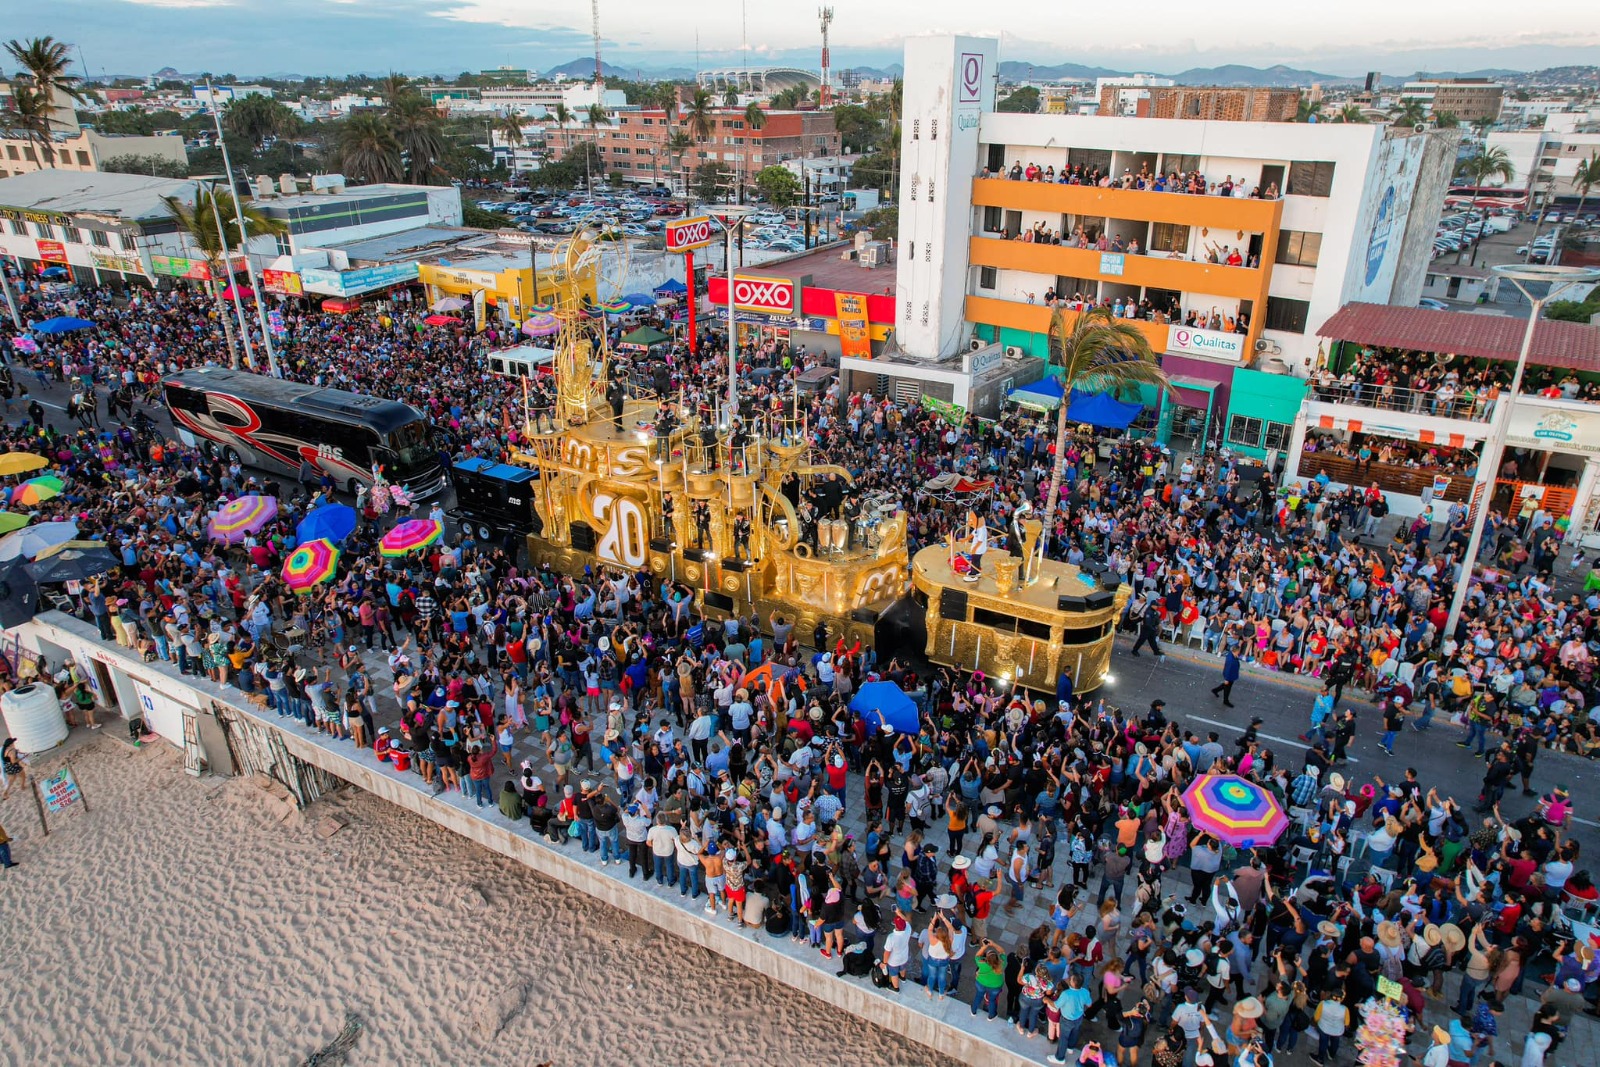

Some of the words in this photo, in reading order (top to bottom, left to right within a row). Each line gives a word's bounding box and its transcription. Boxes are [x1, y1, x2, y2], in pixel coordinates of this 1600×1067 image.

[25, 212, 49, 224] FITNESS
[675, 220, 709, 246] OXXO
[735, 282, 791, 306] OXXO
[318, 443, 343, 461] ms
[593, 494, 645, 567] 20
